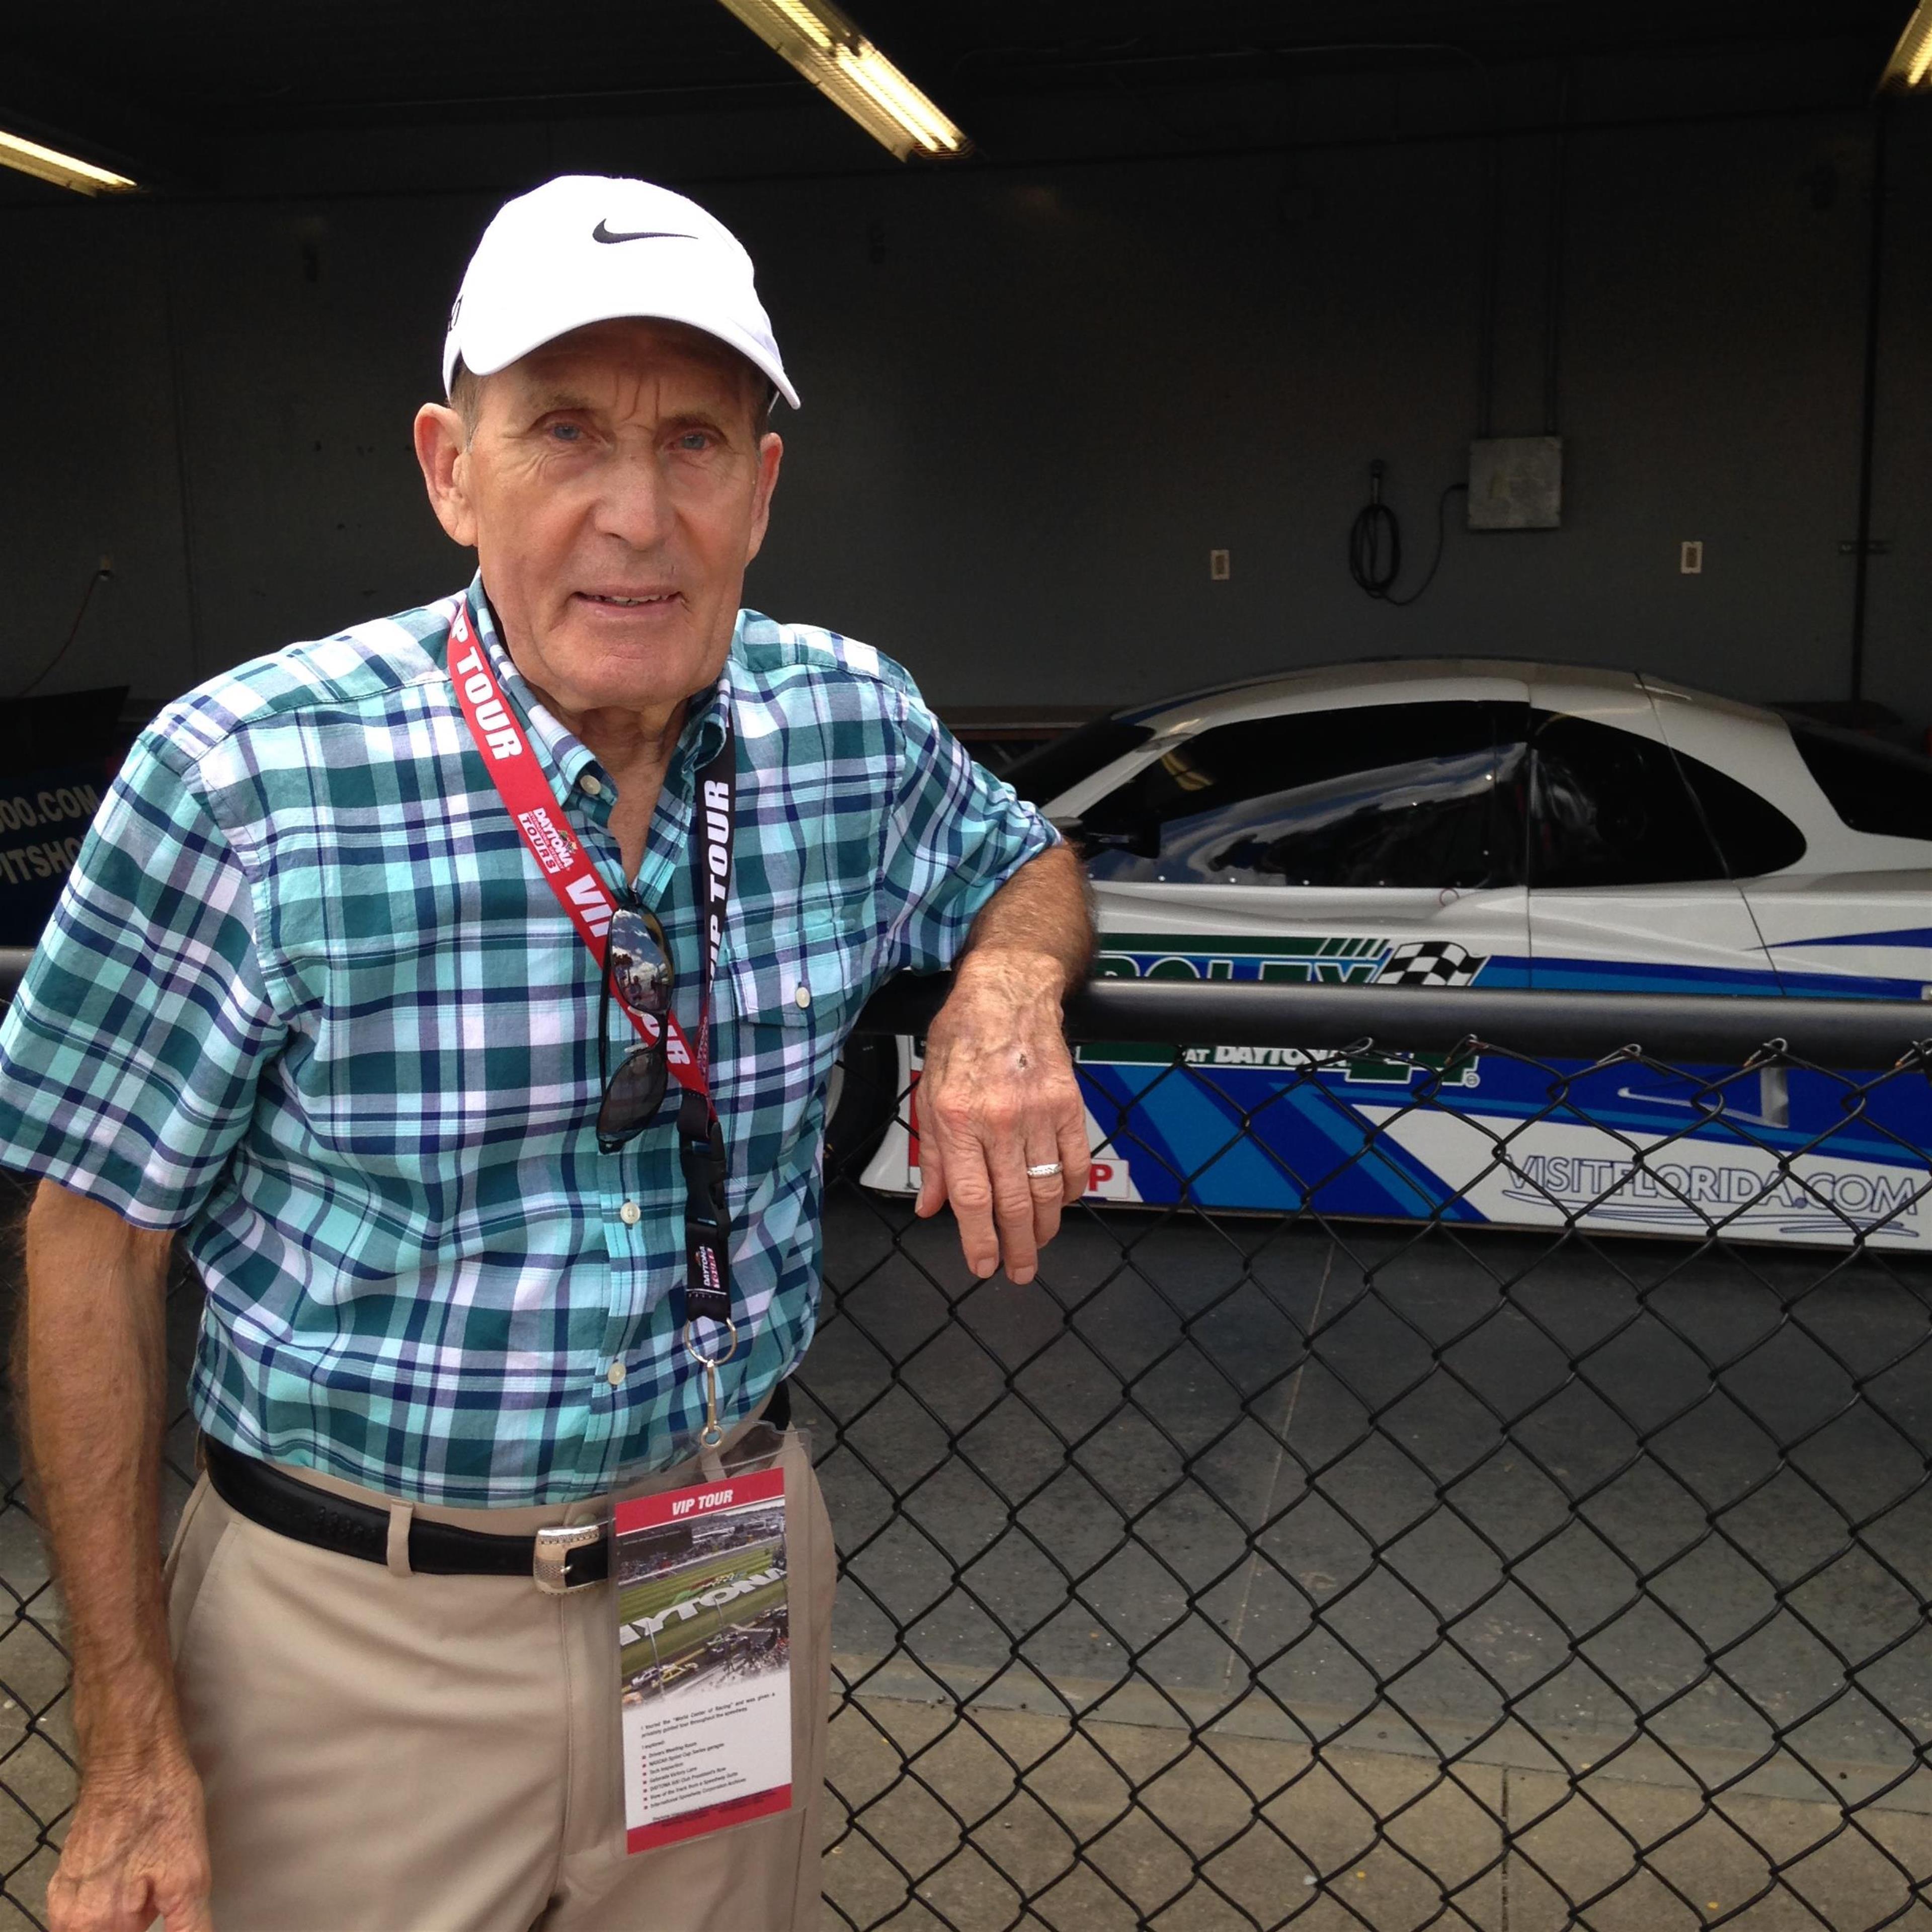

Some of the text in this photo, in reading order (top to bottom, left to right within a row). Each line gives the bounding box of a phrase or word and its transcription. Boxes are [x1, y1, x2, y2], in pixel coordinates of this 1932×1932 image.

[457, 646, 523, 760] TOUR
[522, 816, 556, 869] TOURS
[533, 808, 574, 867] DAYTONA
[704, 780, 729, 903] TOUR
[1184, 1049, 1210, 1062] AT
[1503, 1154, 1918, 1216] VISITFLORIDA.COM
[672, 1489, 734, 1515] VIP TOUR
